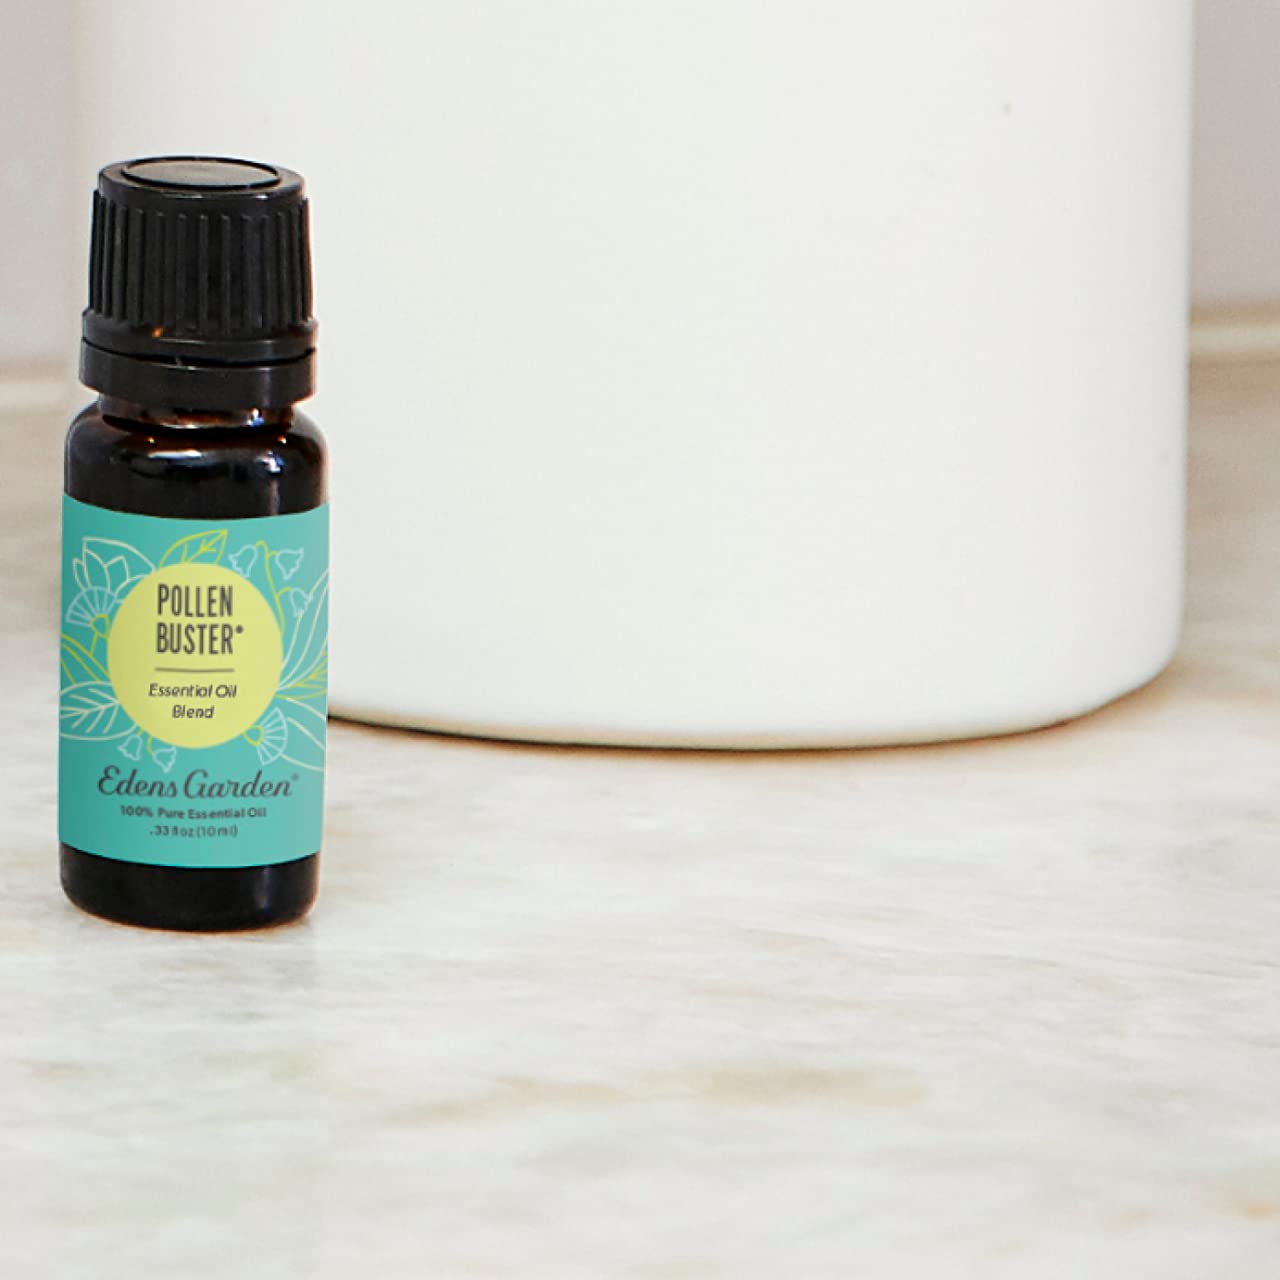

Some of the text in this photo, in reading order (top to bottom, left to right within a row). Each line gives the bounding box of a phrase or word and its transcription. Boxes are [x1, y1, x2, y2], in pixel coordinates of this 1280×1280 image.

[157, 583, 234, 617] POLLEN
[148, 683, 238, 699] Essential Oil
[172, 705, 216, 719] Blend
[98, 765, 178, 798] Edens
[120, 805, 268, 820] 100% Pure Essential Oil
[150, 824, 170, 836] .33
